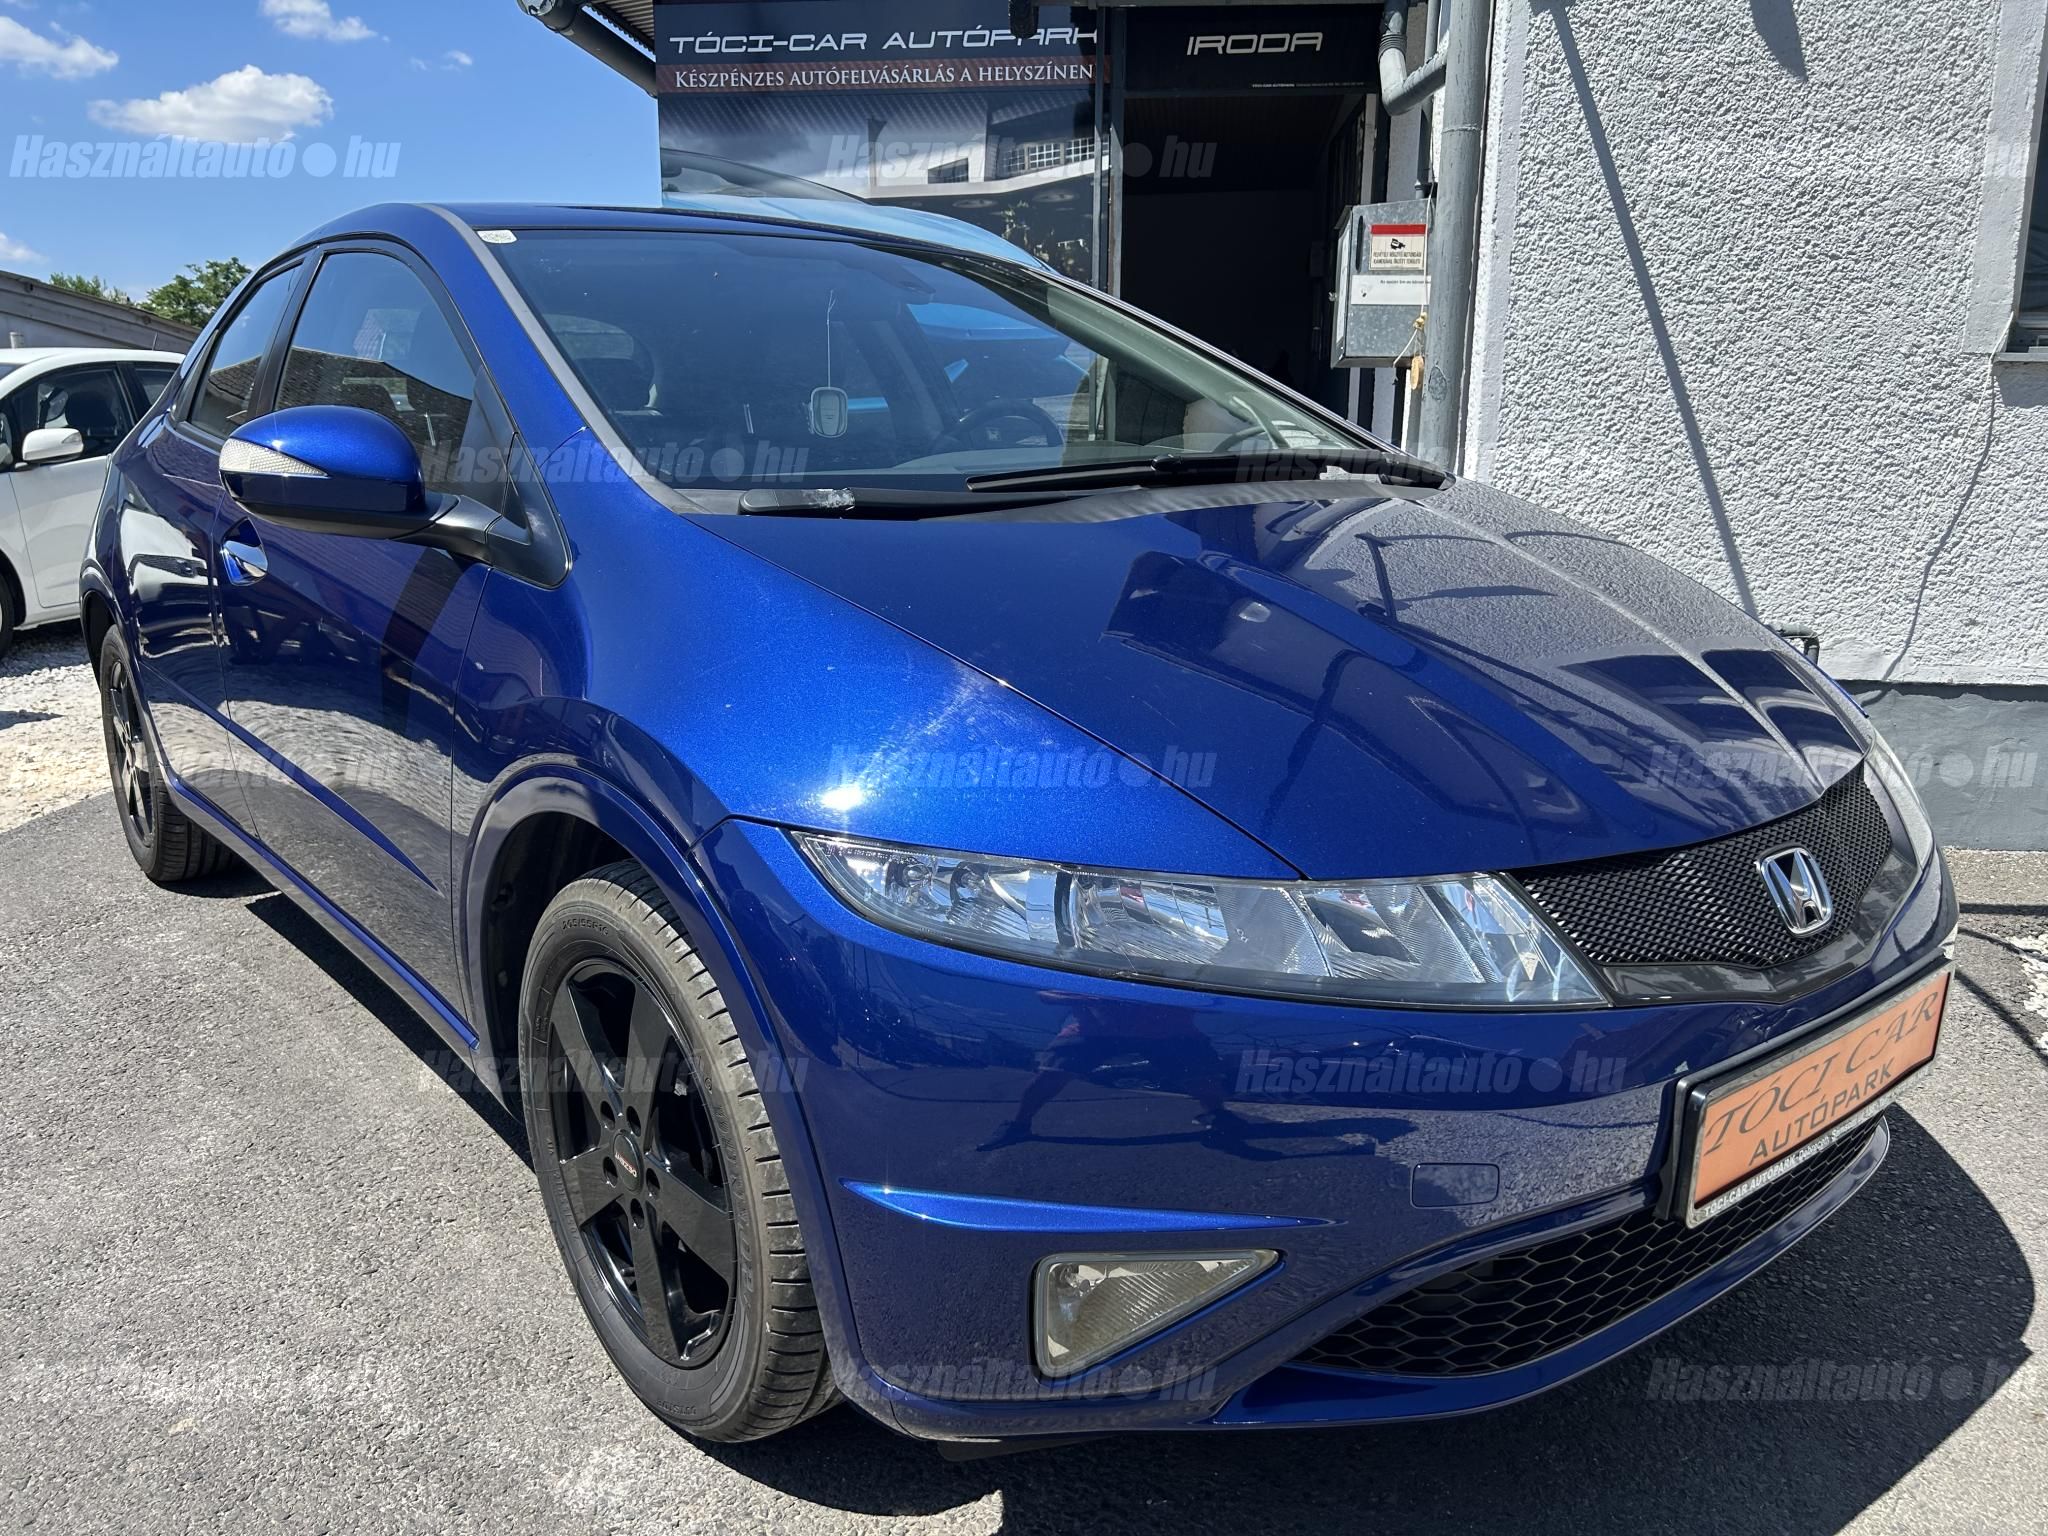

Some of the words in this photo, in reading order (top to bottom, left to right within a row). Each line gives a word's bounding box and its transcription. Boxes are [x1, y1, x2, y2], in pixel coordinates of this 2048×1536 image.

[669, 32, 868, 54] TÓCI-CAR
[1186, 32, 1323, 56] IRODA
[675, 68, 784, 88] KÉSZPÉNZES
[789, 64, 954, 86] AUTÓFELVÁSÁRLÁS
[959, 68, 973, 82] A
[979, 61, 1094, 81] HELYSZÍNEN
[1703, 1052, 1841, 1157] TÓCI
[1845, 991, 1939, 1074] CAR
[1748, 1057, 1896, 1166] AUTÓPARK
